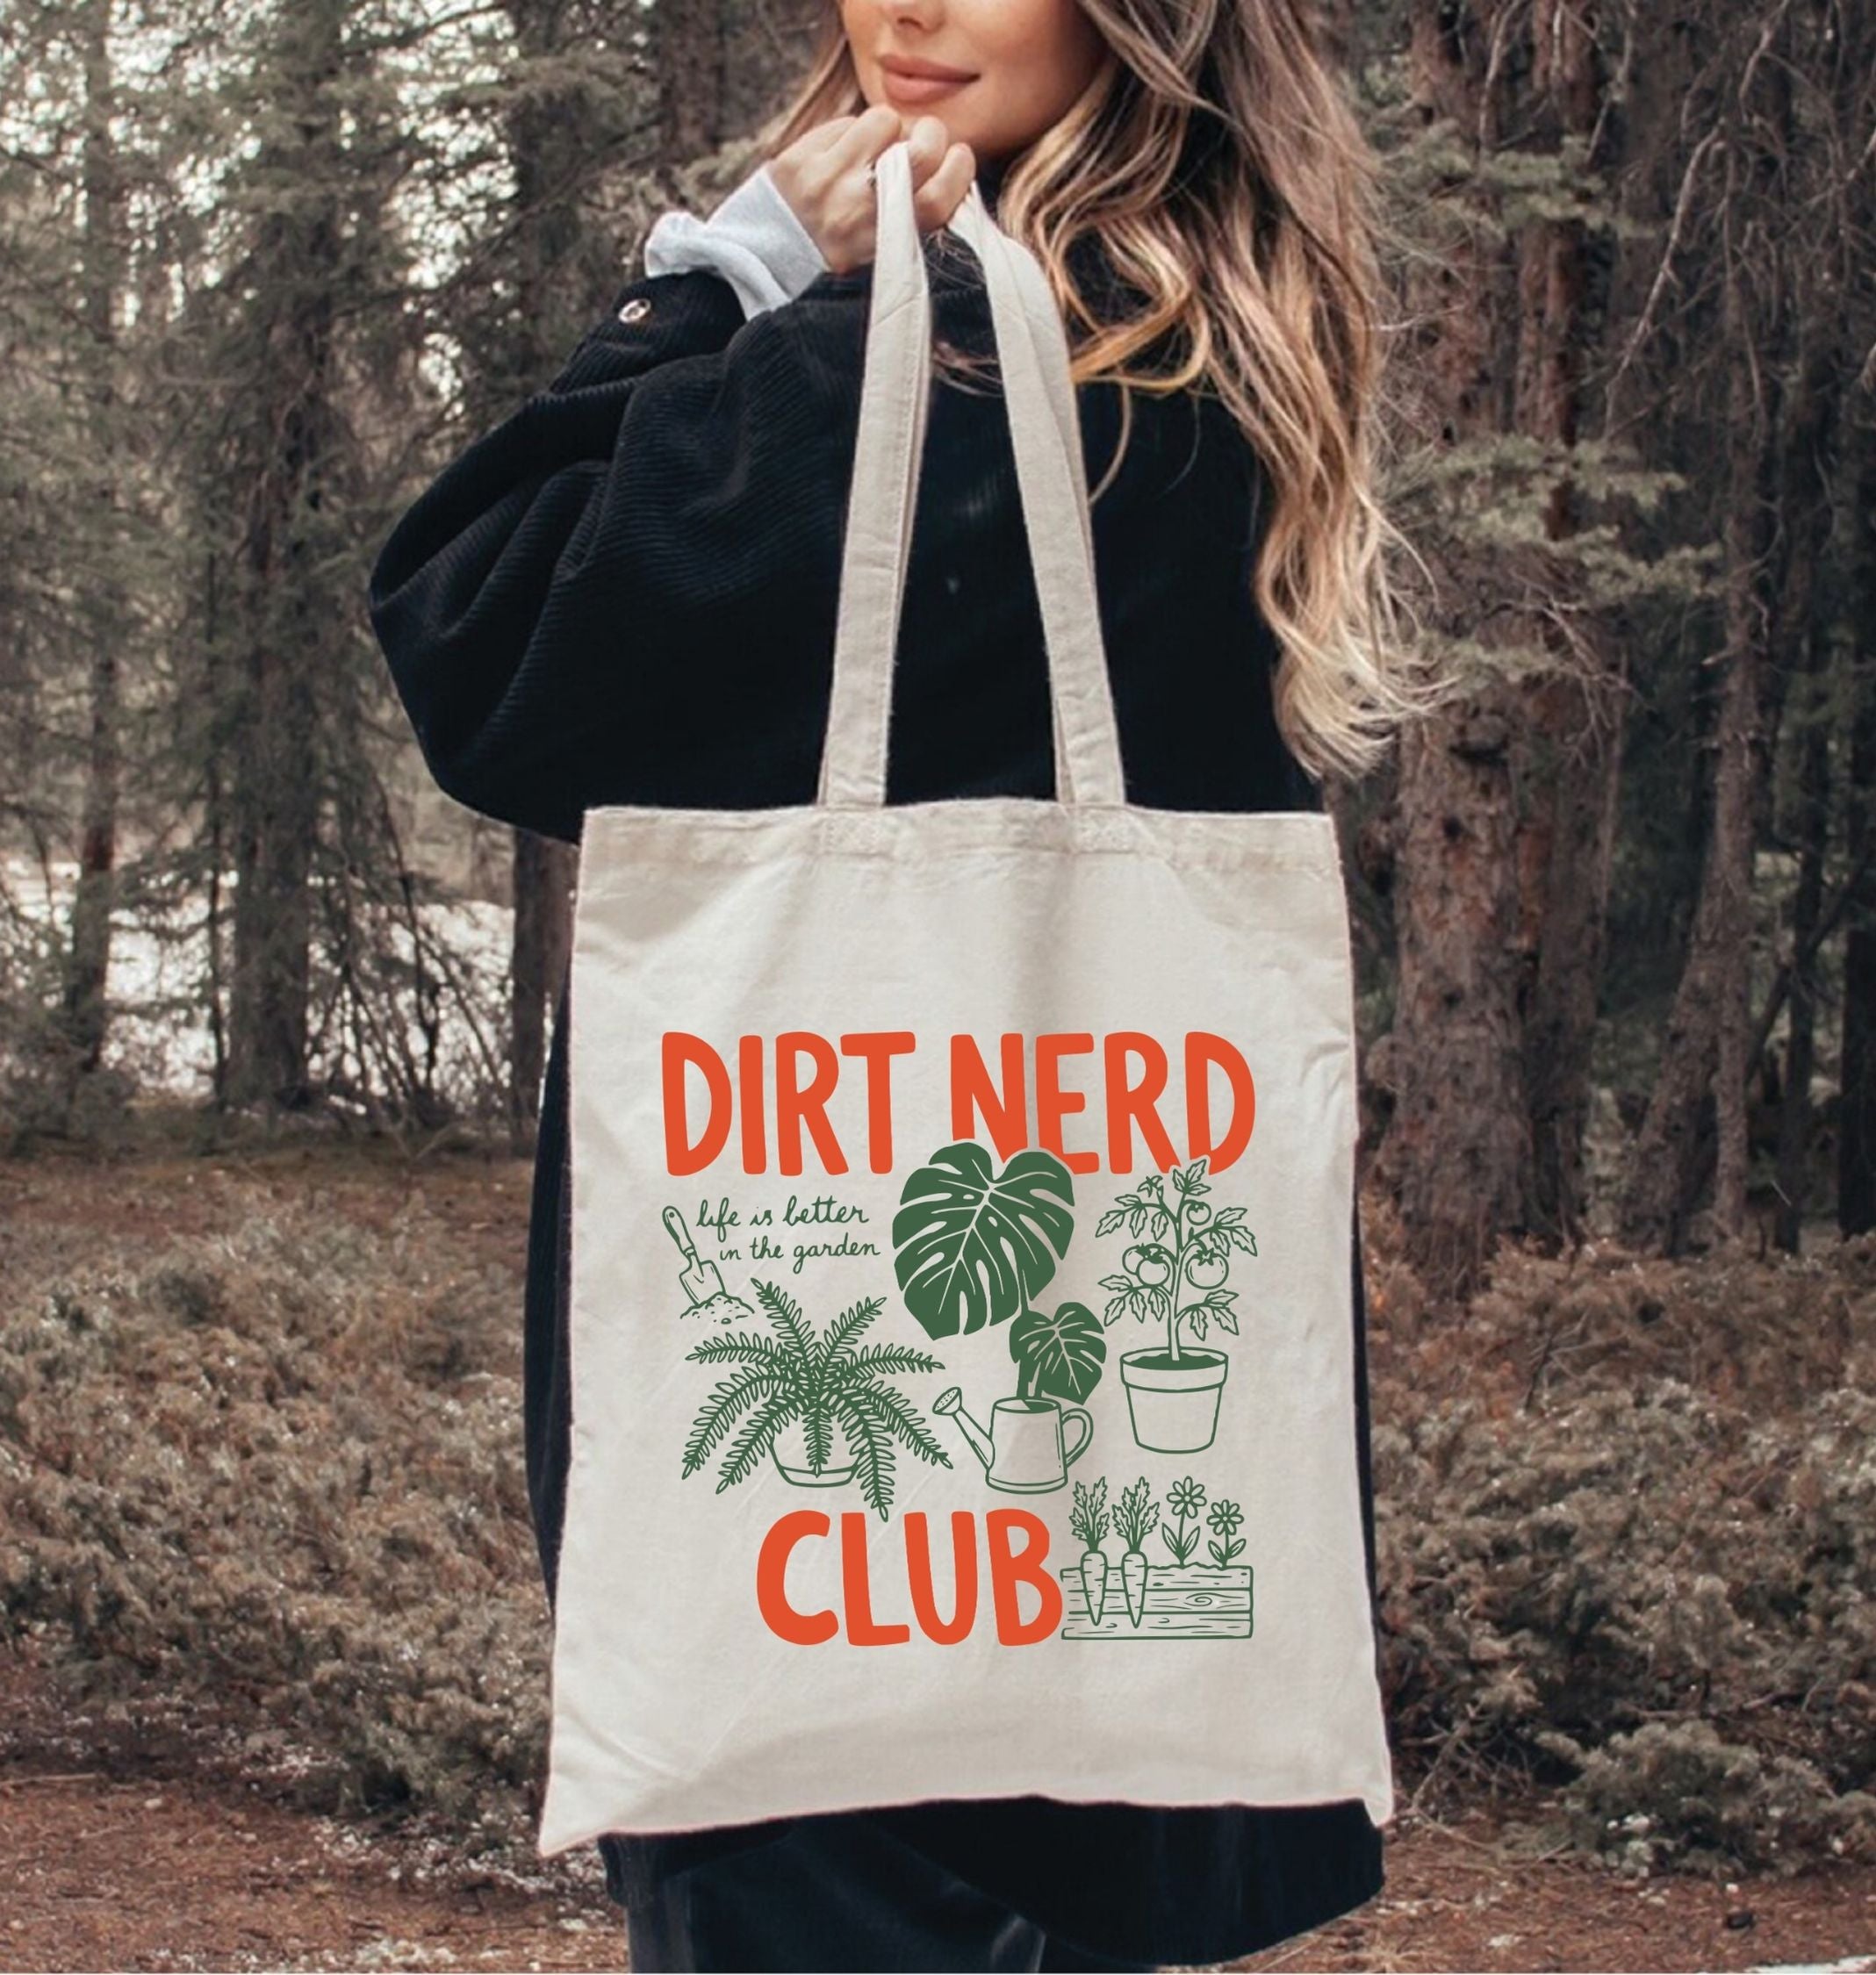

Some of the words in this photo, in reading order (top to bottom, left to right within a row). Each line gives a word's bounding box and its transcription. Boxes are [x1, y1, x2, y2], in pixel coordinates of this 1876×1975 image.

[662, 1031, 916, 1177] DIRT
[951, 1032, 1256, 1175] NERD
[696, 1196, 741, 1243] life
[750, 1206, 773, 1226] is
[782, 1195, 869, 1226] better
[720, 1248, 742, 1260] in
[749, 1235, 784, 1259] the
[793, 1232, 880, 1275] garden
[757, 1509, 1063, 1647] CLUB
